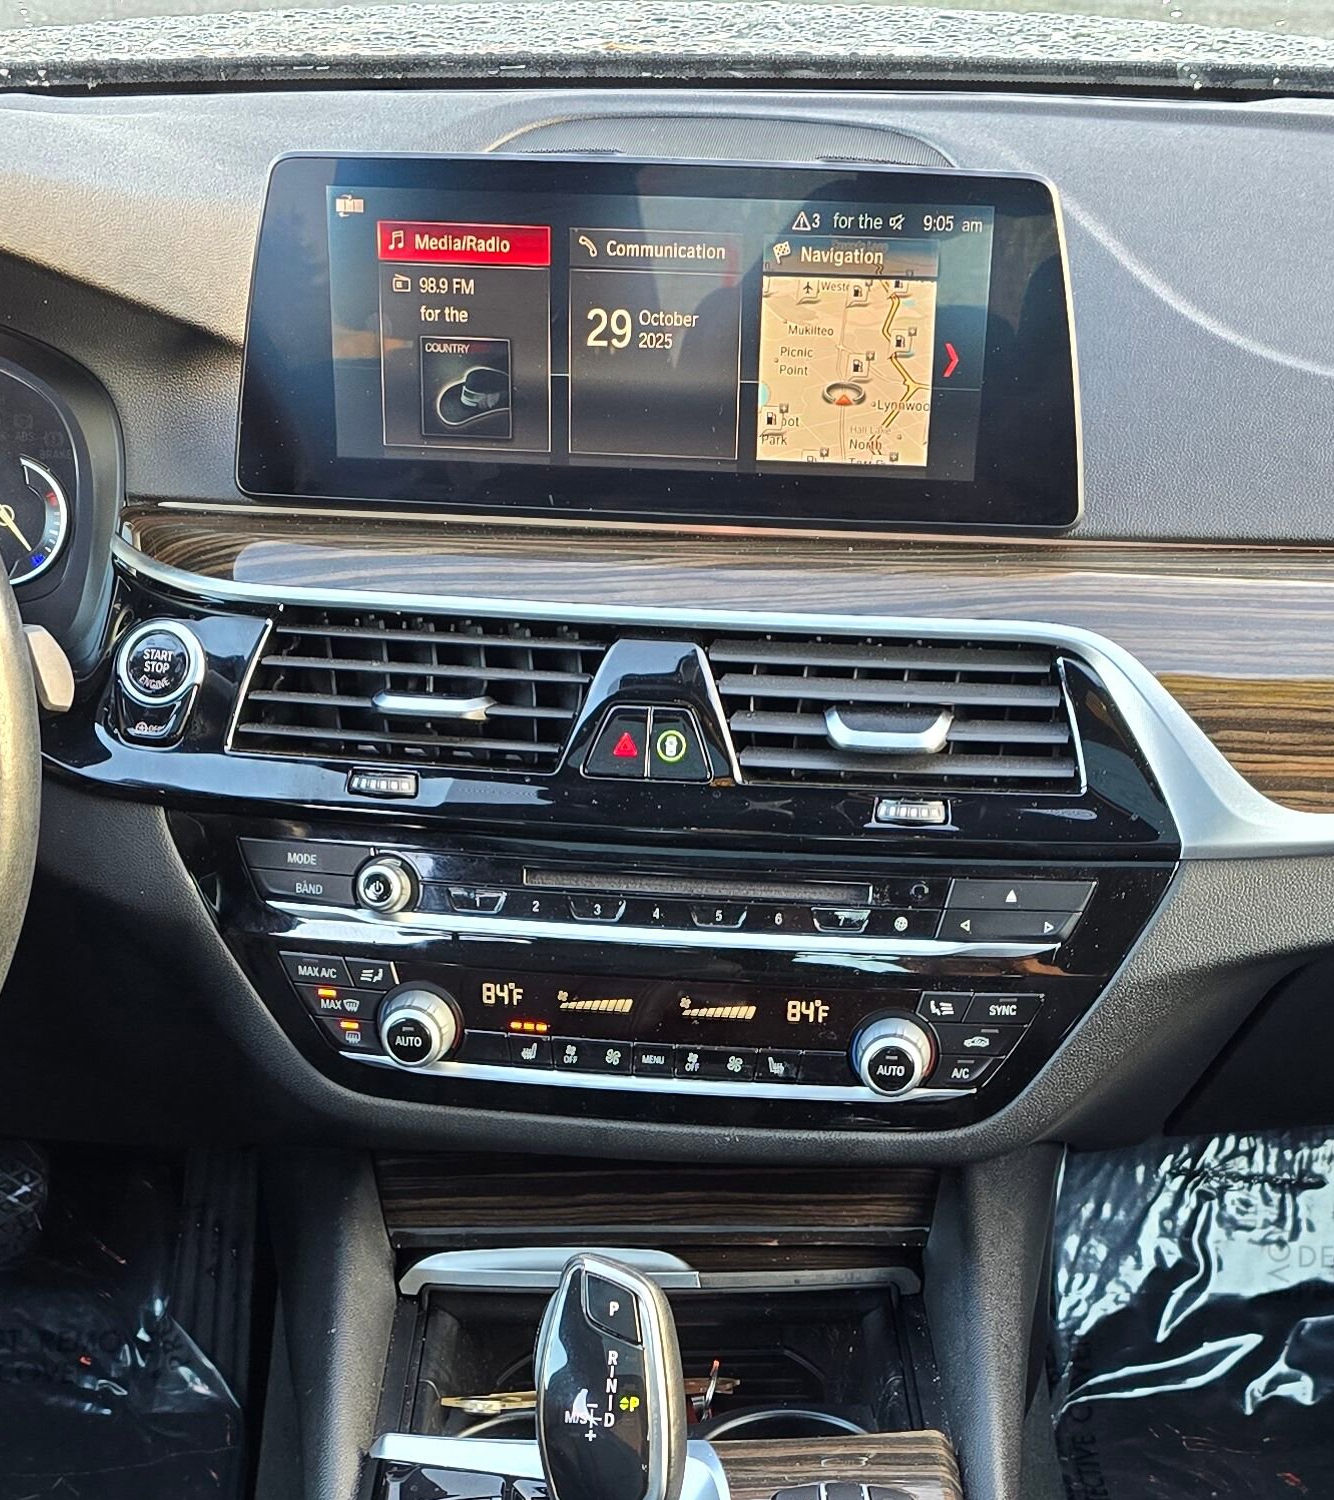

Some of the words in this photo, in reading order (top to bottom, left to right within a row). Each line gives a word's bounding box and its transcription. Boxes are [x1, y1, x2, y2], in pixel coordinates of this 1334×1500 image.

[833, 212, 854, 229] for
[858, 212, 883, 230] the
[923, 214, 955, 232] 9:05
[961, 219, 984, 233] am
[414, 233, 511, 253] Media/Radio
[606, 240, 726, 260] Communication
[800, 246, 884, 267] Navigation
[418, 276, 448, 294] 98.9
[452, 278, 475, 296] FM
[419, 305, 441, 322] for
[443, 306, 469, 323] the
[638, 309, 699, 328] October
[586, 307, 632, 349] 29
[787, 324, 835, 337] Mukilteo
[424, 342, 471, 354] COUNTRY
[638, 332, 673, 350] 2025
[780, 346, 814, 358] Picnic
[779, 364, 809, 376] Point
[143, 648, 174, 662] START
[143, 660, 170, 674] STOP
[138, 674, 171, 690] ENGINE
[287, 852, 317, 866] MODE
[295, 881, 323, 895] BAND
[531, 900, 540, 913] 2
[593, 903, 602, 916] 3
[651, 907, 660, 920] 4
[714, 909, 723, 922] 5
[774, 912, 783, 925] 6
[298, 965, 320, 977] MAX
[320, 967, 337, 979] A/C
[320, 998, 342, 1010] MAX
[989, 1004, 1017, 1016] SYNC
[395, 1035, 423, 1048] AUTO
[563, 1055, 578, 1064] OFF
[641, 1054, 665, 1065] MENU
[684, 1062, 700, 1072] OFF
[875, 1064, 906, 1078] AUTO
[951, 1067, 971, 1080] A/C
[609, 1301, 620, 1317] P
[607, 1350, 619, 1366] R
[605, 1378, 618, 1394] N
[603, 1412, 615, 1428] D
